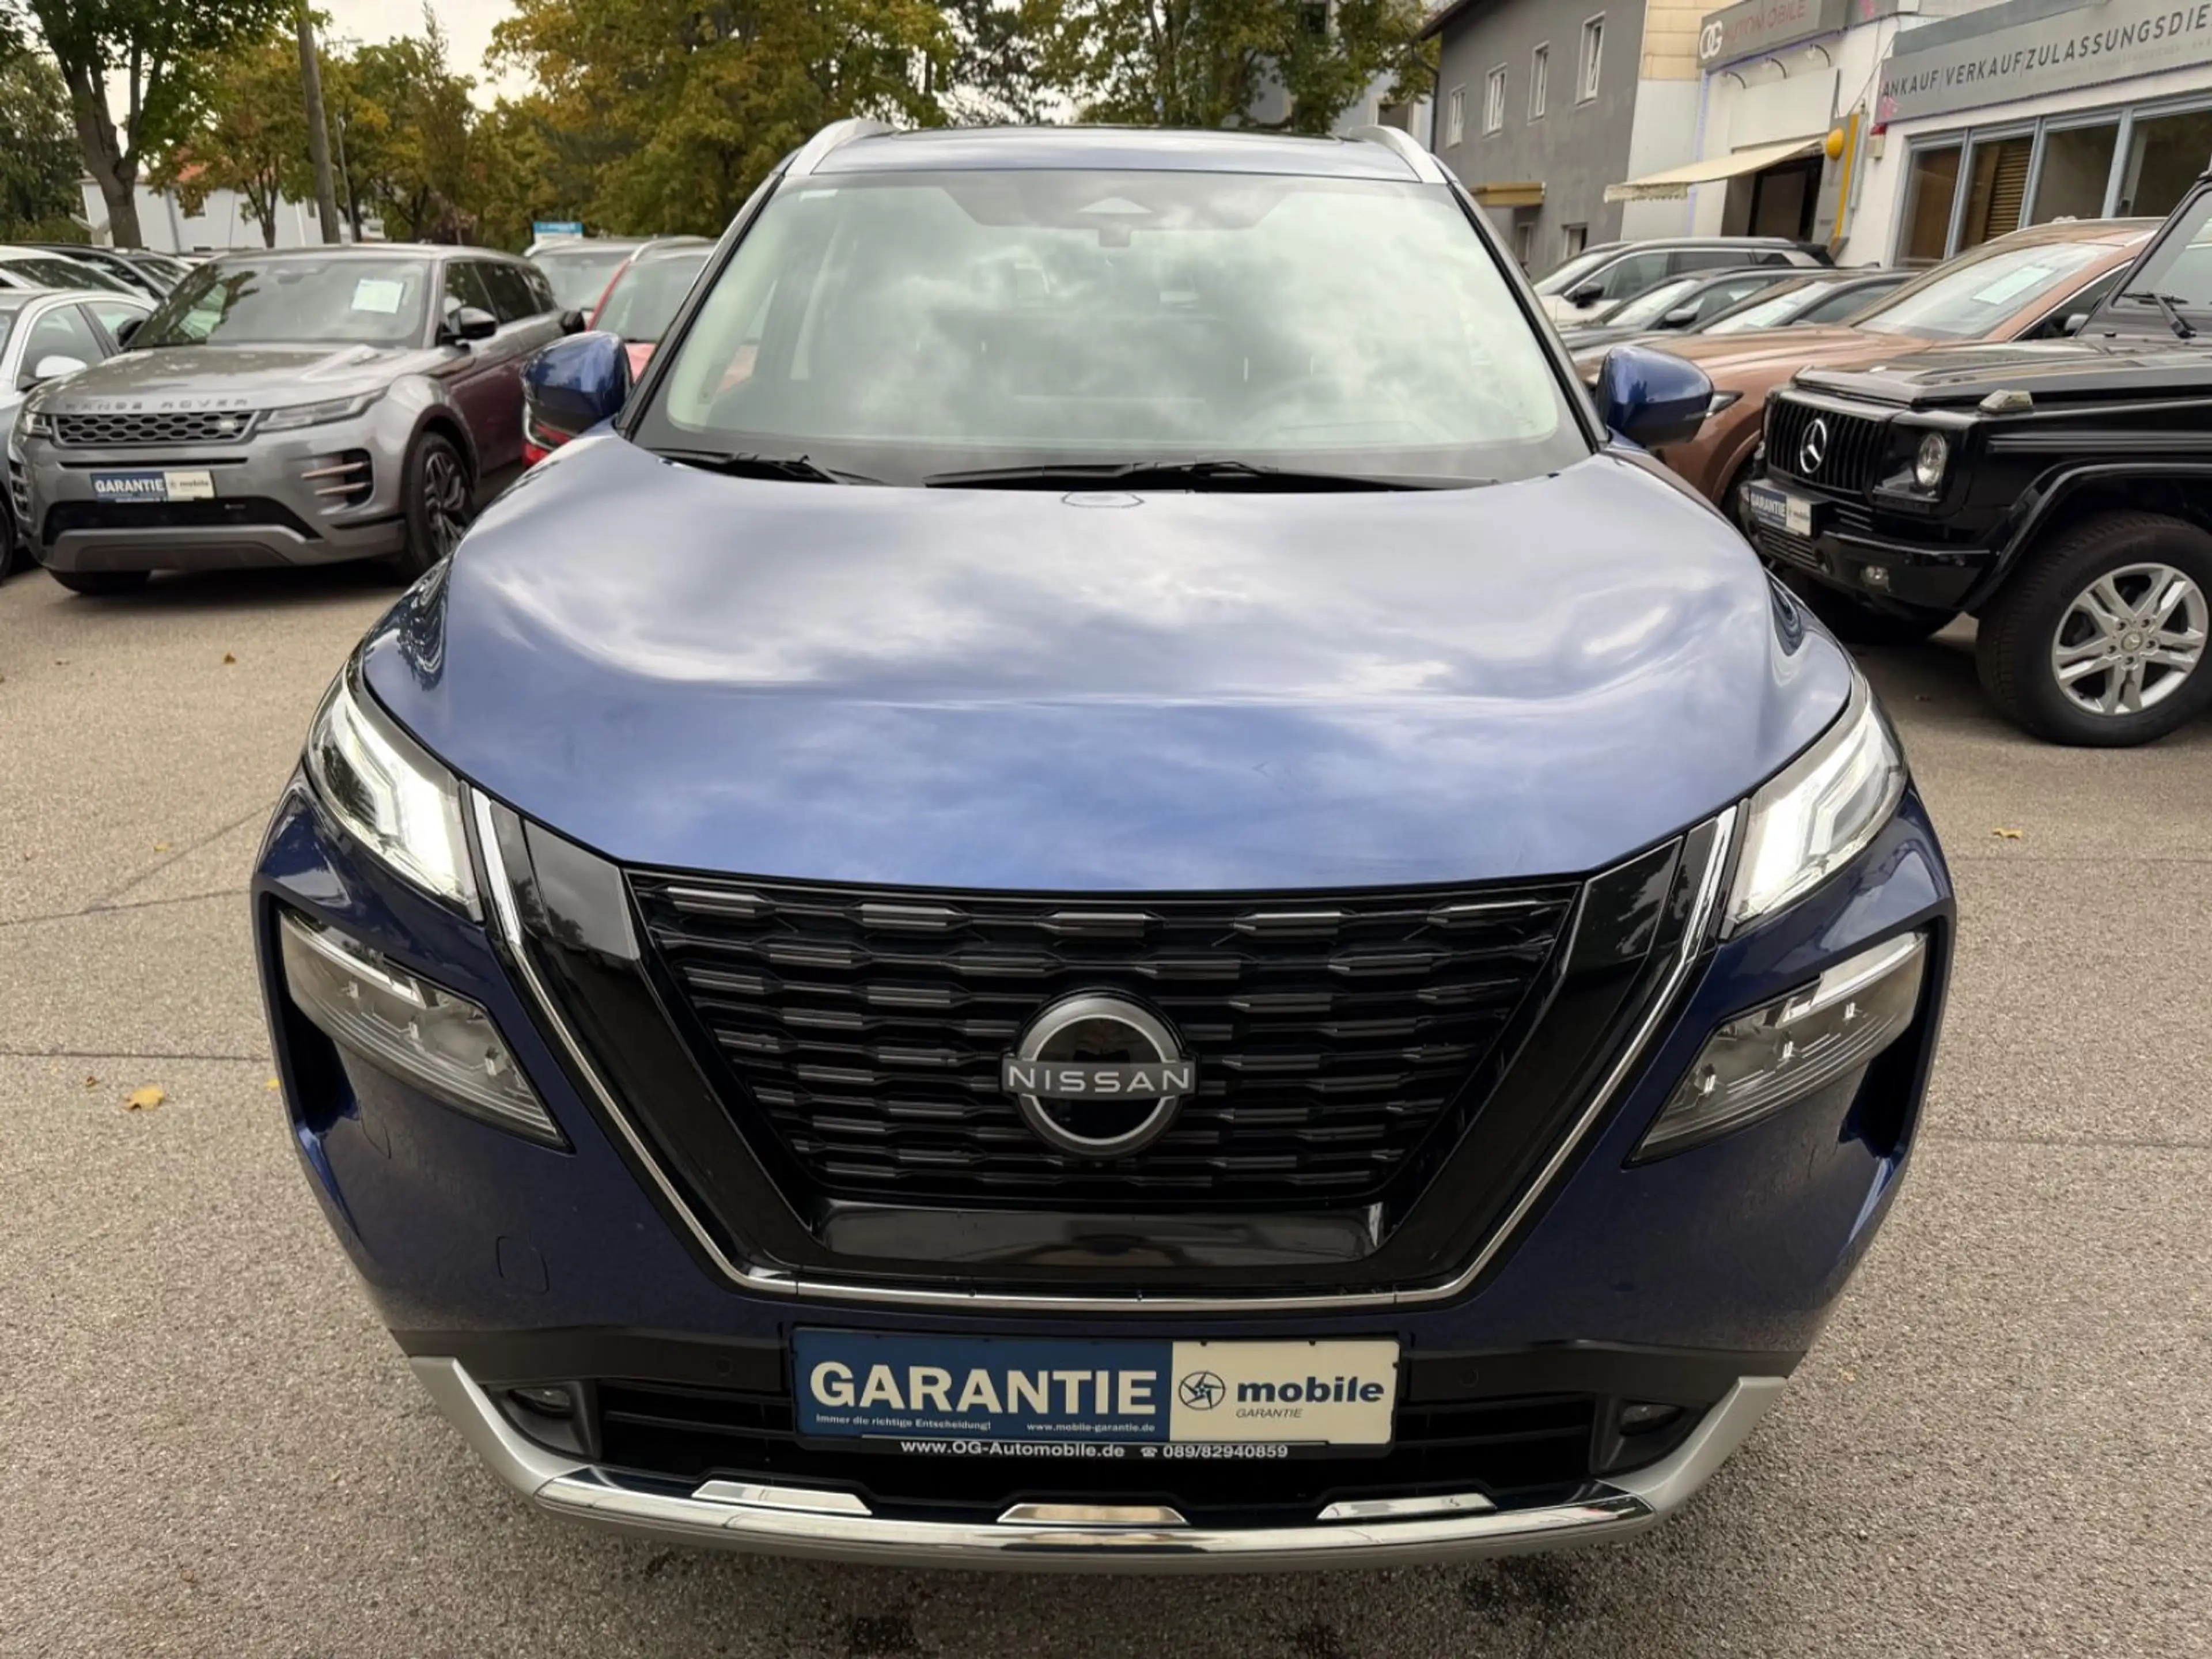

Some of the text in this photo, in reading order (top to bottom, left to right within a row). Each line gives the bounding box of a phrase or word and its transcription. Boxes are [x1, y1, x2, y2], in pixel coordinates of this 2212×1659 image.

[1882, 70, 1940, 99] ANKAUF
[1944, 51, 2025, 86] VERKAUF
[2025, 3, 2212, 69] ZULASSUNGSDIE
[95, 478, 165, 493] GARANTIE
[1009, 1066, 1189, 1093] NISSAN
[810, 1361, 1157, 1415] GARANTIE
[1237, 1376, 1384, 1403] mobile
[816, 1414, 991, 1431] Immer die richtige Entscheidung!
[1236, 1408, 1303, 1418] GARANTIE
[1027, 1422, 1156, 1433] www.mobile-garantie.de
[901, 1440, 1288, 1459] www.OG-Automobile.de 089/82940859
